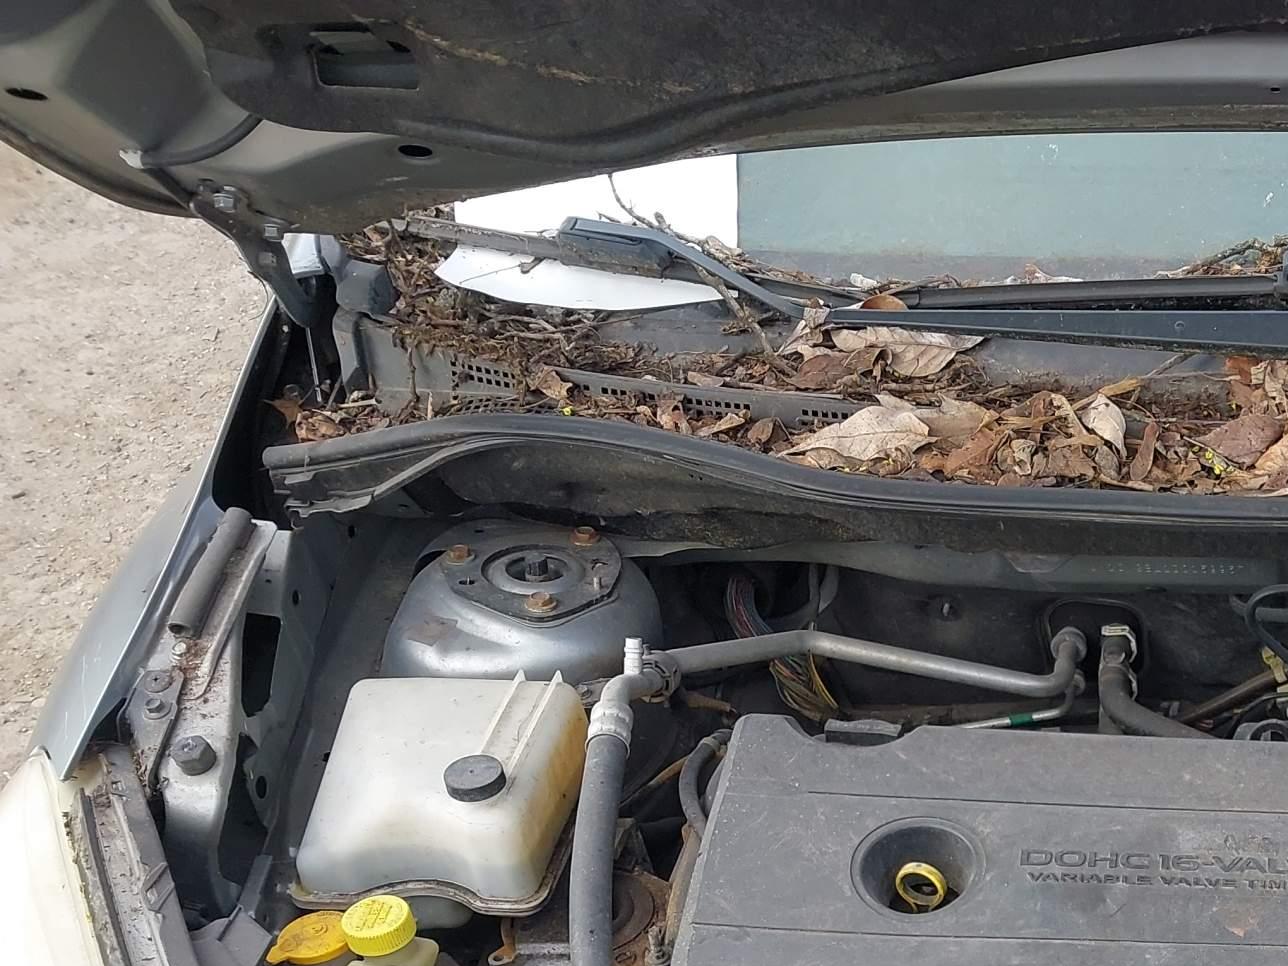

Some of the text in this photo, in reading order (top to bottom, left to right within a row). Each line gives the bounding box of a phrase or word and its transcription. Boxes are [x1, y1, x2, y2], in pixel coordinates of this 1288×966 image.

[1019, 848, 1151, 870] DOHC
[1026, 870, 1153, 887] VARIABLE
[1158, 874, 1239, 890] VALVE
